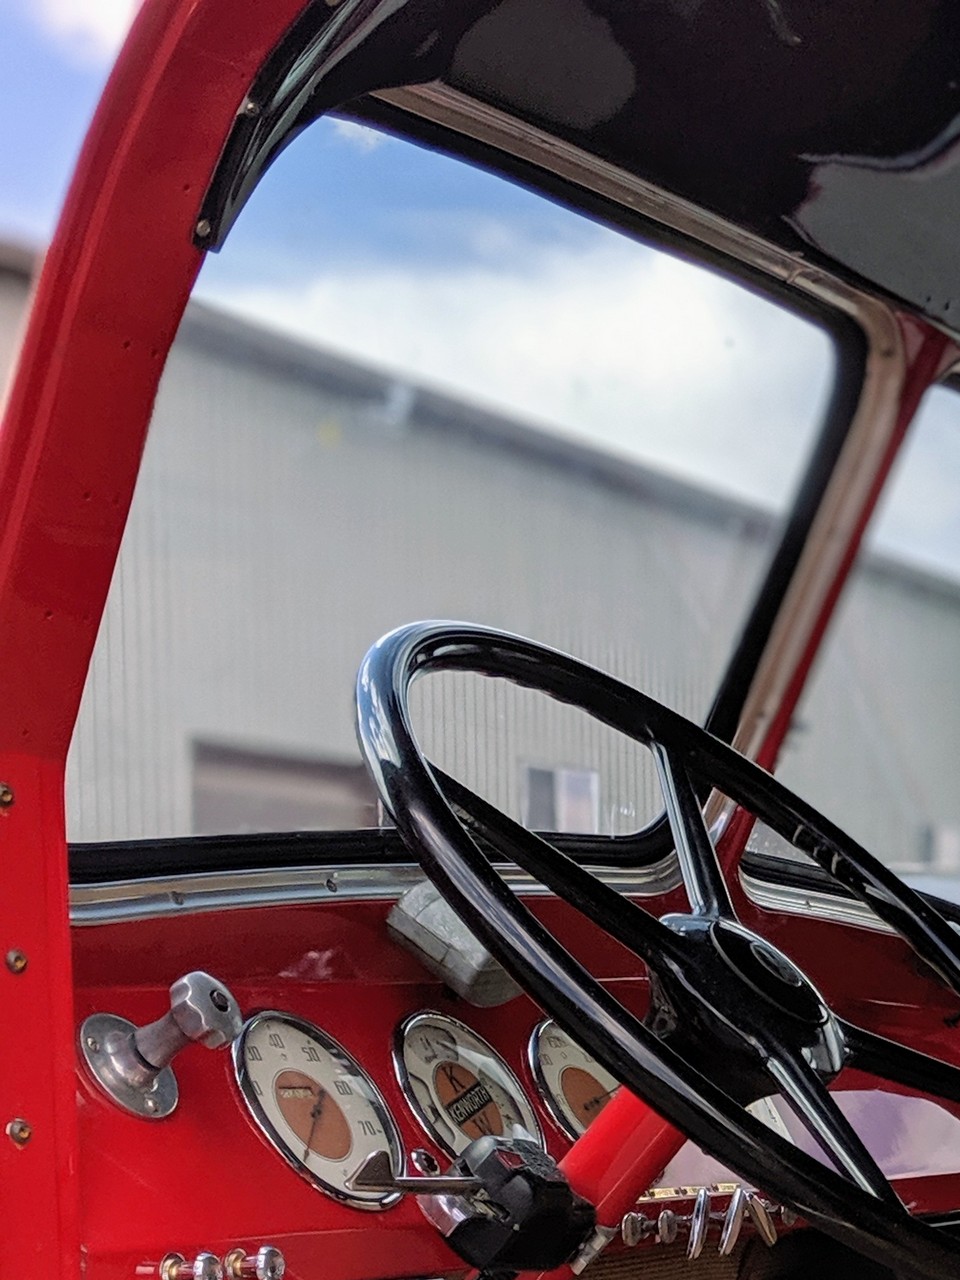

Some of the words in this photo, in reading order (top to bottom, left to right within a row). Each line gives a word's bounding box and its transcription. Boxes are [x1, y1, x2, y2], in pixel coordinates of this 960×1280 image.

[269, 1033, 285, 1049] 40
[247, 1046, 262, 1061] 30
[301, 1047, 321, 1062] 50
[334, 1080, 352, 1096] 60
[448, 1086, 492, 1122] KENWORTH
[358, 1120, 376, 1136] 70
